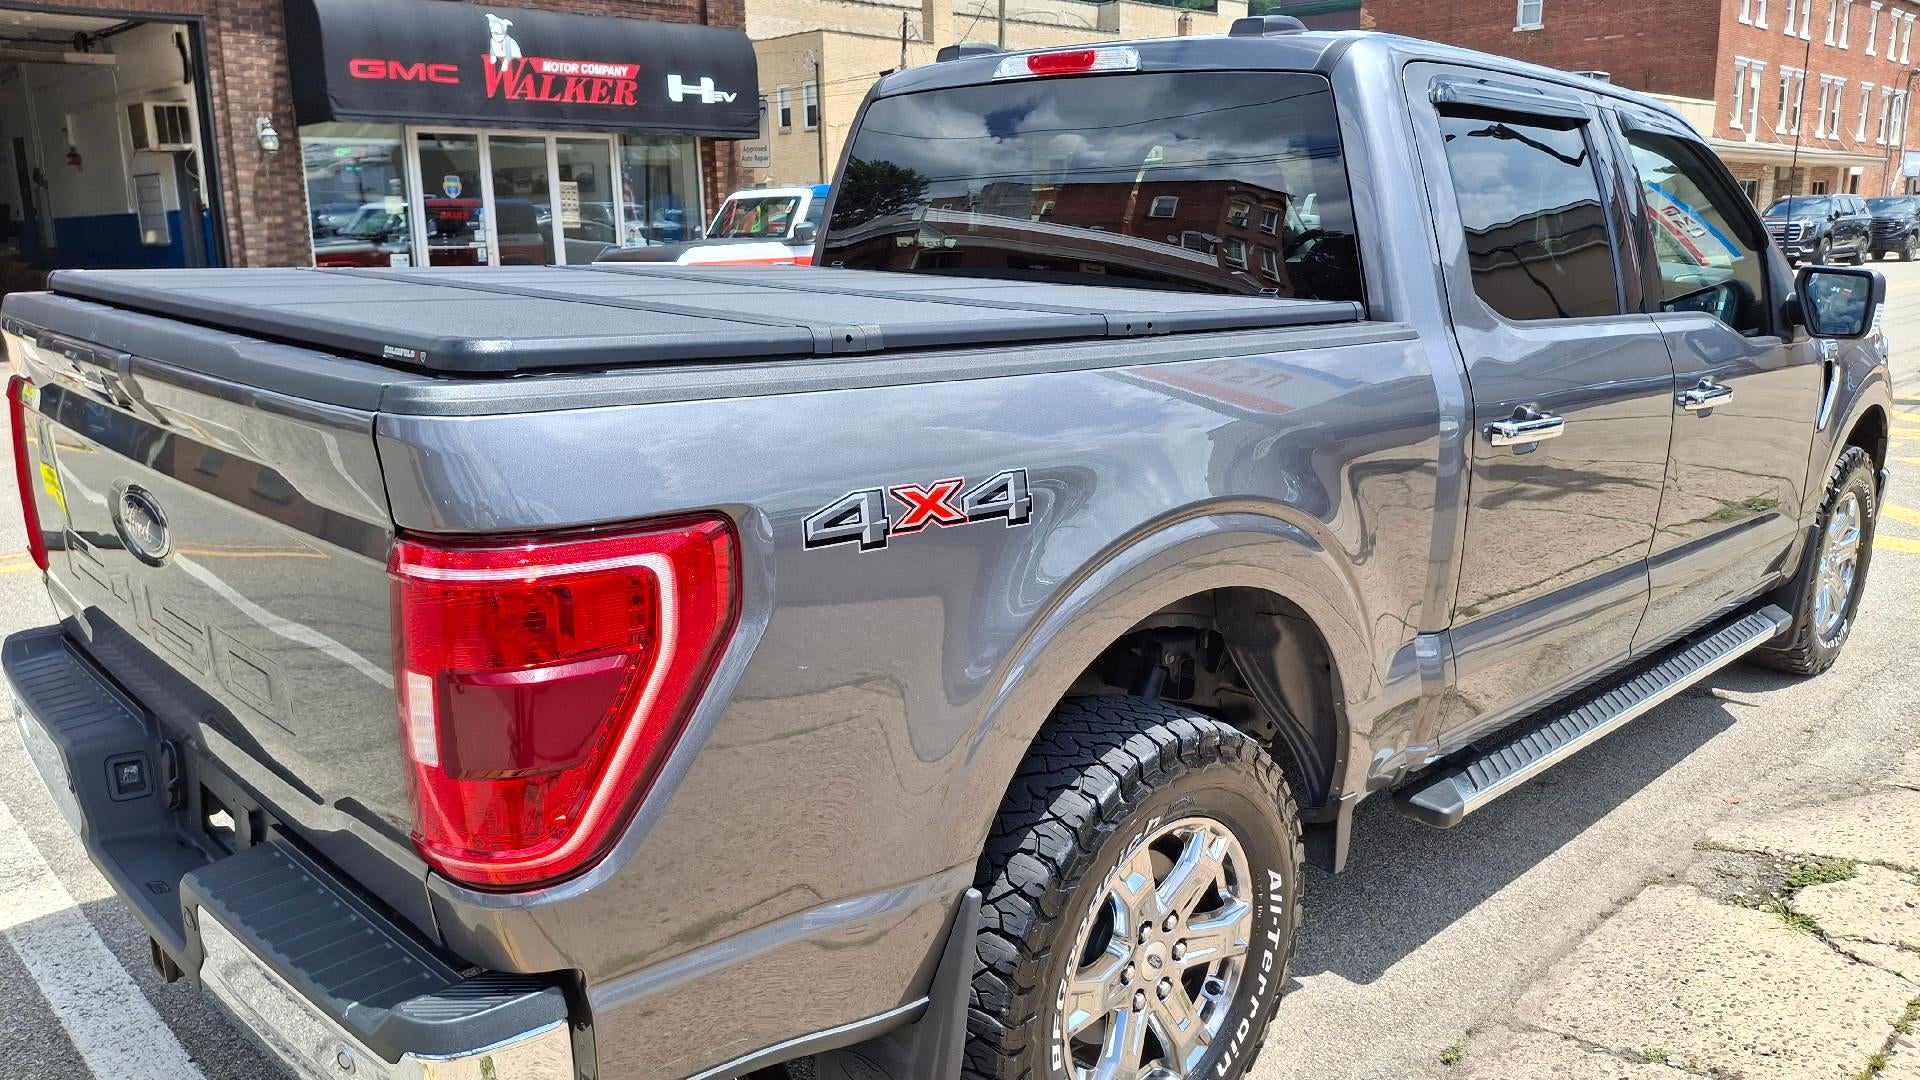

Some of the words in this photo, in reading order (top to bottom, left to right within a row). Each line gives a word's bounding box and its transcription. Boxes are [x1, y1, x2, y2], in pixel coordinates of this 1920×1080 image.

[349, 58, 460, 84] GMC
[481, 54, 638, 106] WALKER
[542, 61, 579, 73] MOTOR
[580, 63, 629, 77] COMPANY
[1215, 868, 1283, 1078] All-Terrain
